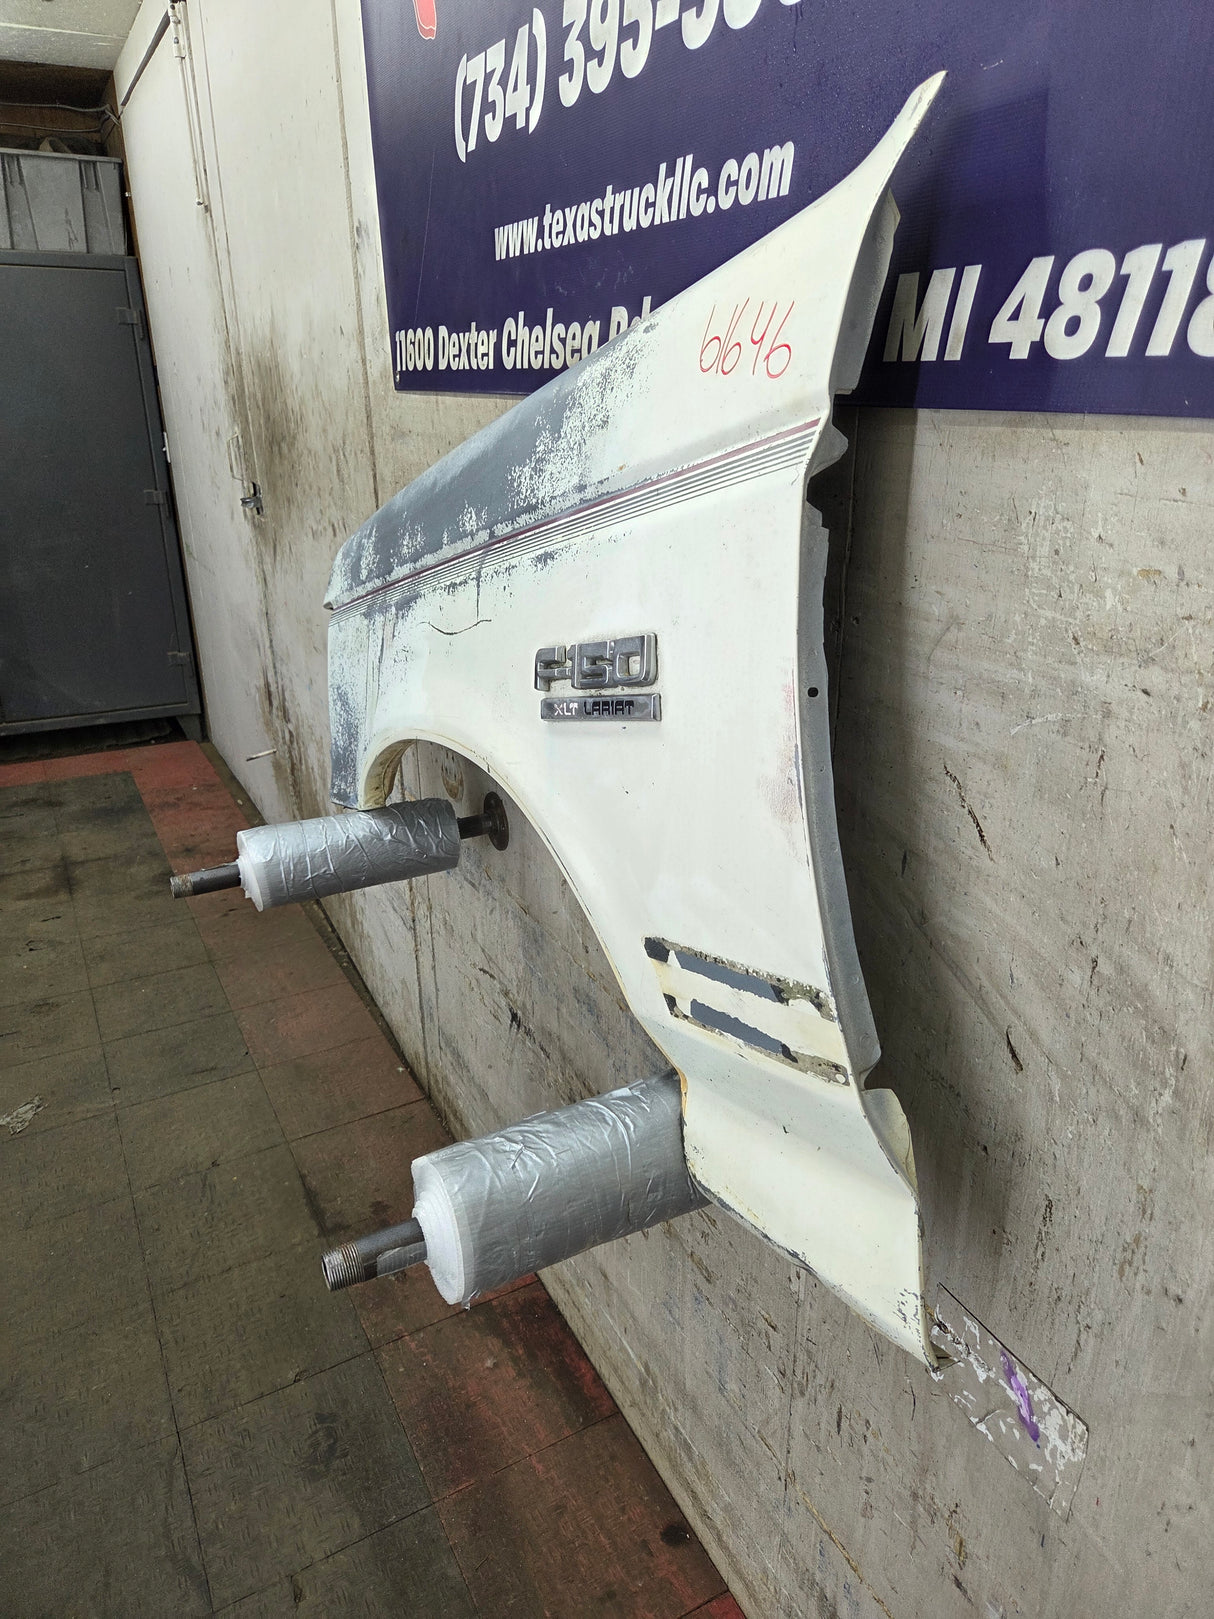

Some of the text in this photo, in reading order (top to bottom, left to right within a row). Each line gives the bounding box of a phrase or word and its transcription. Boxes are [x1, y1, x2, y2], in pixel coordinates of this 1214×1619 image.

[455, 8, 547, 163] (734)
[494, 141, 795, 261] www.texastruckllc.com
[395, 326, 433, 371] 11600
[438, 322, 497, 370] Dexter
[882, 264, 983, 362] MI
[553, 700, 635, 716] XLT LARIAT
